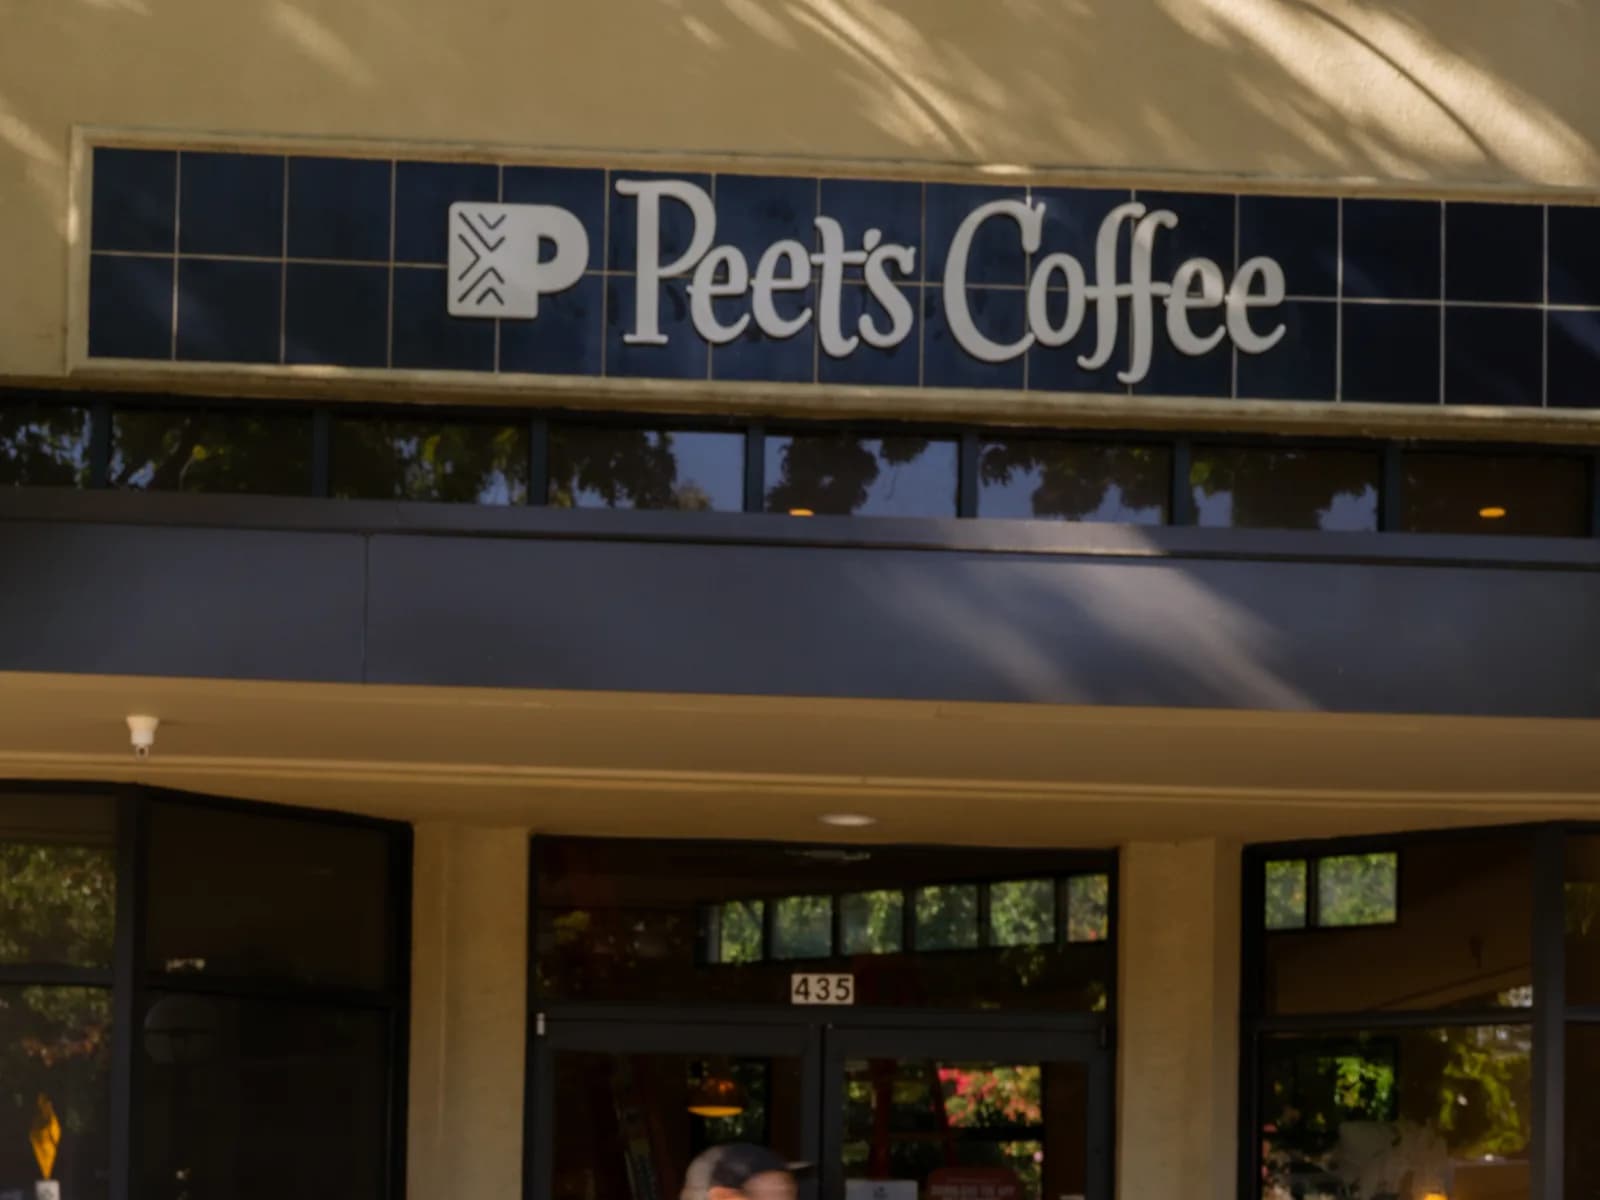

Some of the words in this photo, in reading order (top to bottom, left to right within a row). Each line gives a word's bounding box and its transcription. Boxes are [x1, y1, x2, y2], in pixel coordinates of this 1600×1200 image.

[614, 178, 916, 357] Peet's
[943, 193, 1287, 384] Coffee
[794, 976, 851, 1001] 435
